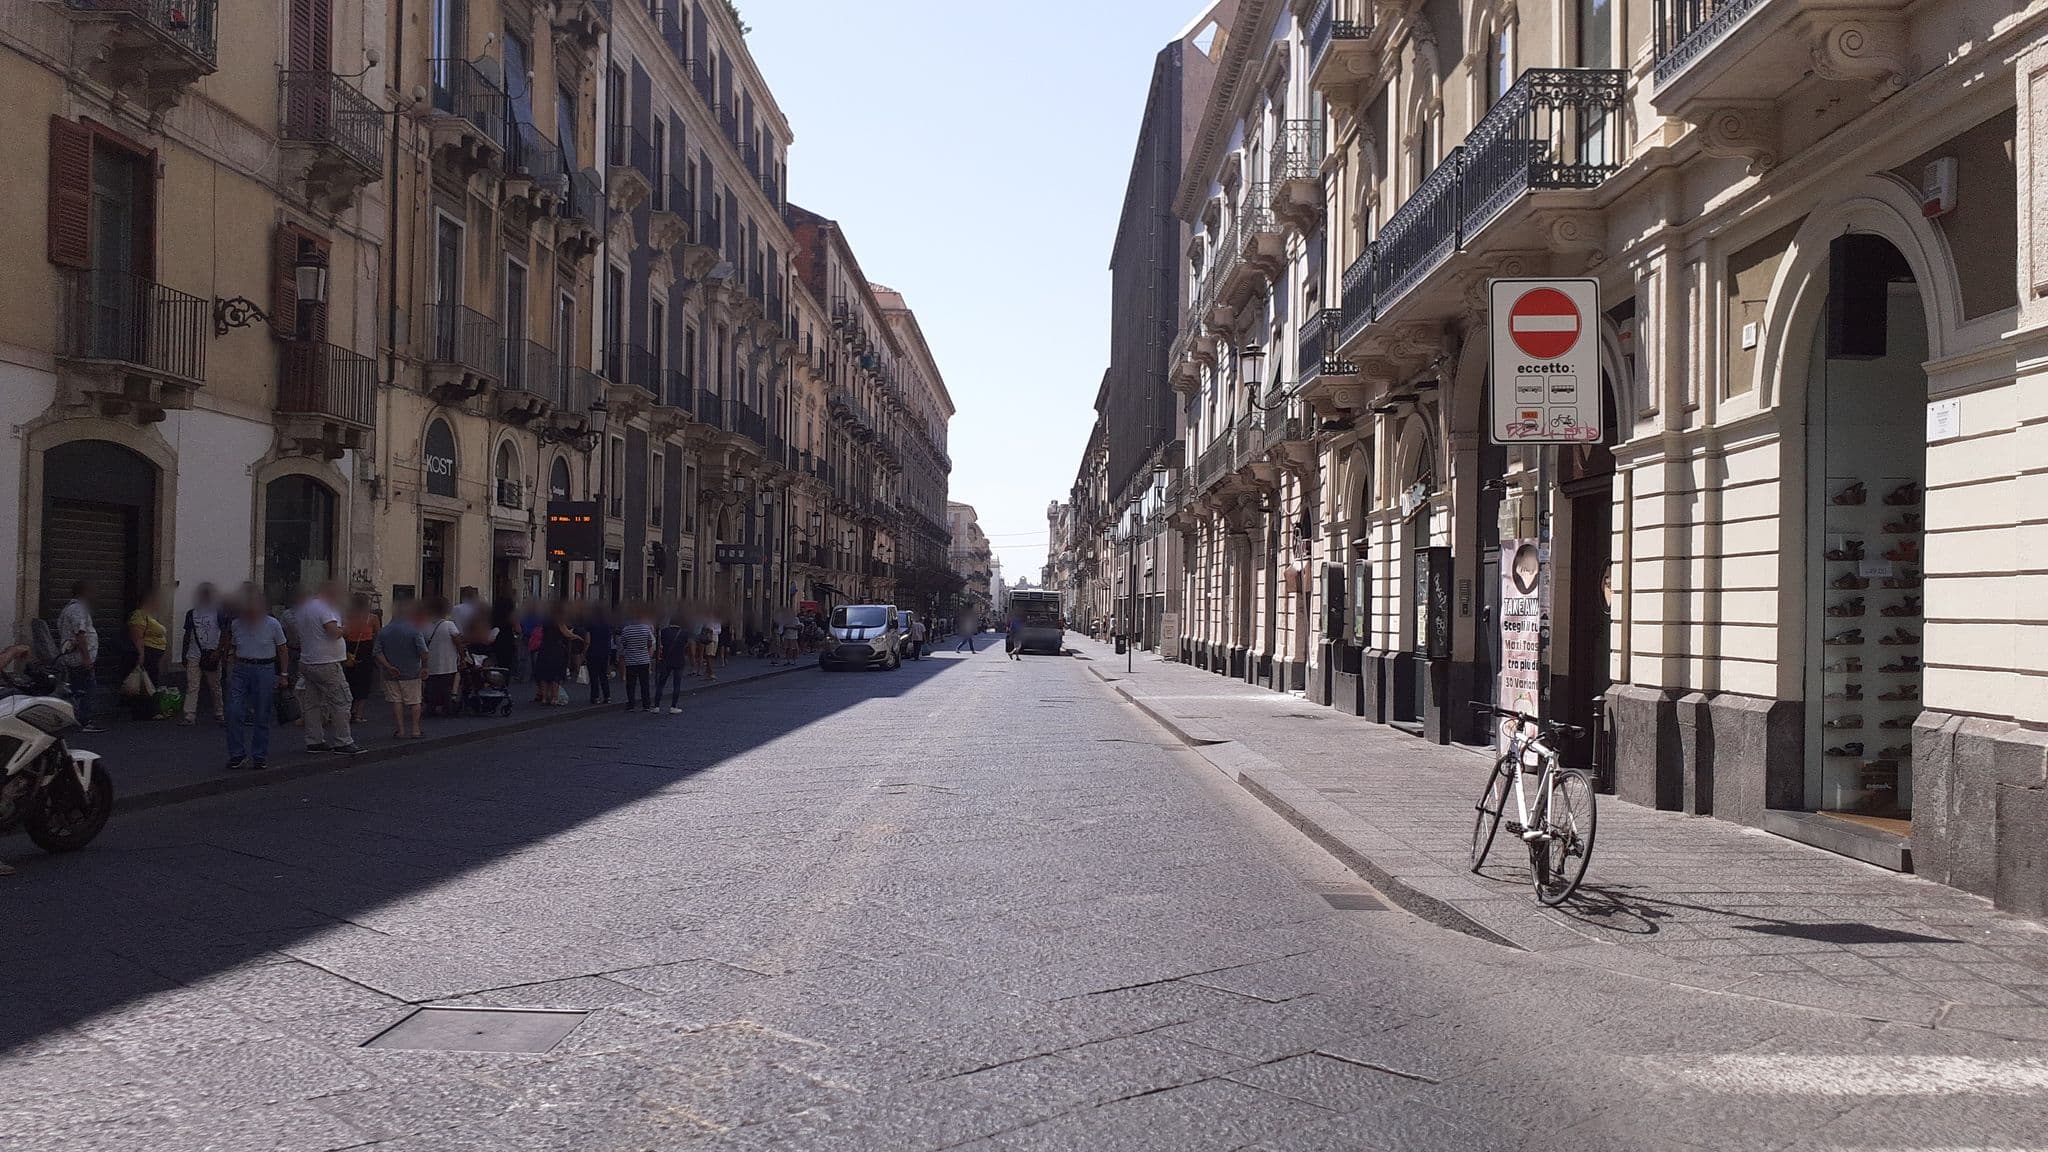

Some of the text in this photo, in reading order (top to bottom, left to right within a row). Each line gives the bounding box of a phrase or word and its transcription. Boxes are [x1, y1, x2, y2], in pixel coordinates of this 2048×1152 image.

[1517, 362, 1575, 374] eccetto:
[426, 453, 453, 477] KOST
[1504, 598, 1524, 616] TAKE
[1504, 620, 1525, 633] Scegli
[1505, 640, 1539, 651] Maxi Toas
[1508, 659, 1519, 669] tra
